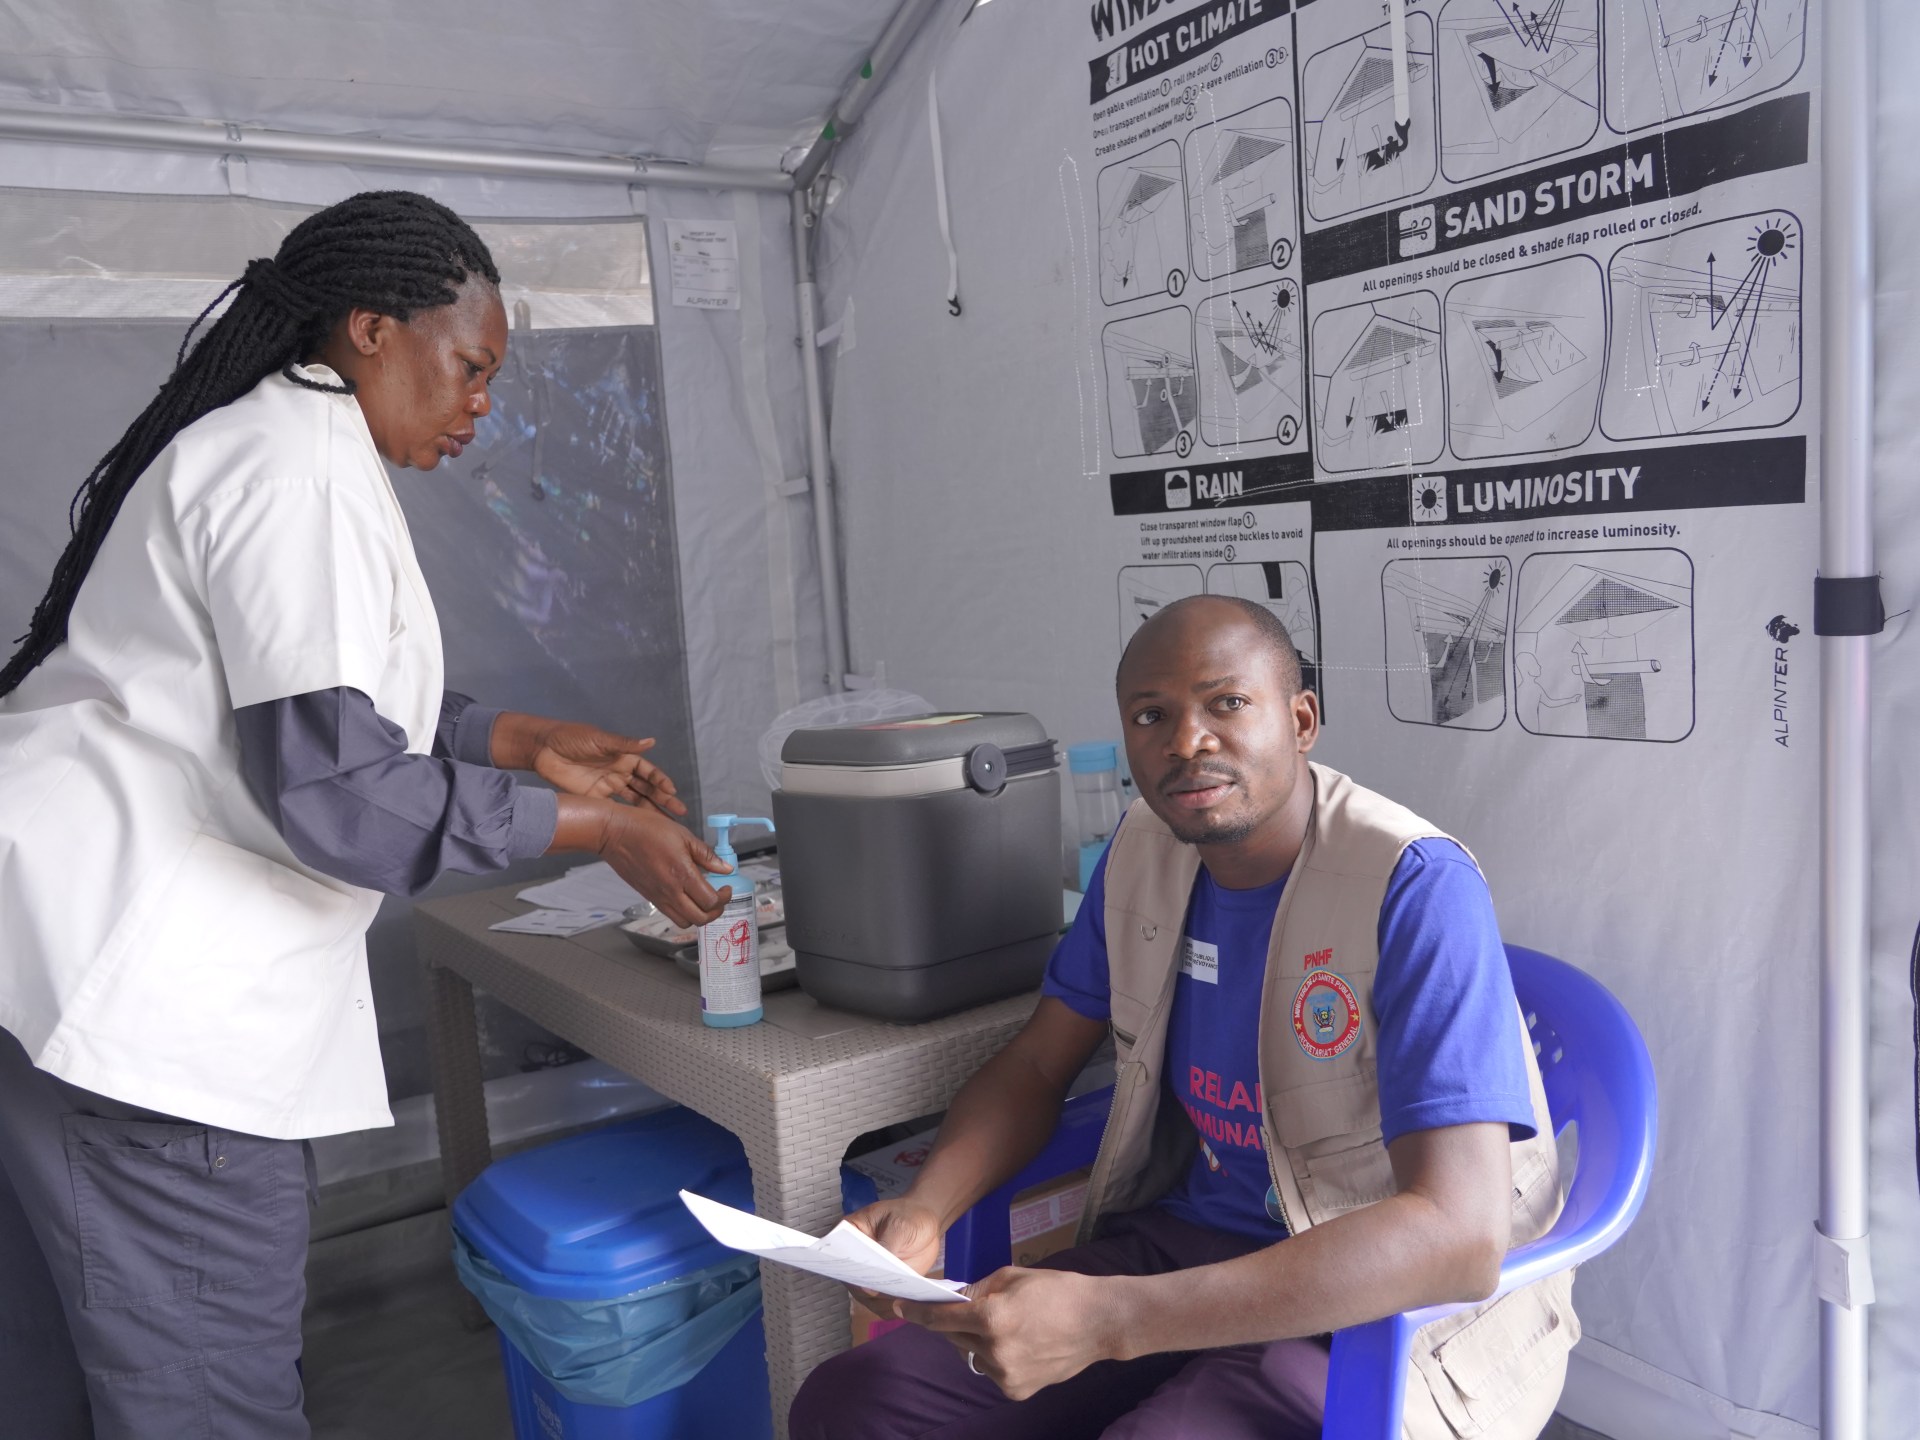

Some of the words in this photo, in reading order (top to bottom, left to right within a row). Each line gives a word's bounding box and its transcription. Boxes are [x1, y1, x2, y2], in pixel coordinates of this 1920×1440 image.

[1131, 32, 1171, 73] HOT
[1176, 0, 1263, 53] CLIMATE
[1106, 102, 1124, 118] gable
[1126, 88, 1160, 106] ventilation
[1186, 68, 1196, 80] the
[1197, 62, 1210, 76] door
[1109, 111, 1147, 133] transparent
[1148, 101, 1170, 118] window
[1170, 95, 1182, 108] flap
[1206, 76, 1222, 90] eave
[1224, 60, 1264, 82] ventilation
[1095, 142, 1116, 157] Create
[1117, 134, 1138, 148] shades
[1138, 128, 1150, 140] with
[1152, 119, 1173, 134] window
[1174, 112, 1185, 124] flap
[1444, 190, 1527, 238] SAND
[1534, 152, 1654, 216] STORM
[1362, 280, 1377, 292] All
[1379, 271, 1424, 290] openings
[1426, 260, 1460, 278] should
[1462, 258, 1476, 270] be
[1480, 248, 1515, 266] closed
[1518, 245, 1528, 258] &
[1531, 237, 1564, 254] shade
[1566, 231, 1590, 246] flap
[1593, 218, 1636, 240] rolled
[1640, 217, 1656, 230] or
[1660, 202, 1702, 226] closed.
[1196, 470, 1244, 500] RAIN
[1456, 466, 1642, 513] LUMINOSITY
[1140, 522, 1158, 532] Close
[1158, 519, 1199, 531] transparent
[1200, 518, 1226, 528] window
[1228, 516, 1242, 528] flap
[1152, 538, 1160, 546] up
[1162, 533, 1204, 546] groundsheet
[1205, 533, 1217, 543] and
[1218, 532, 1238, 542] close
[1239, 530, 1270, 542] buckles
[1271, 530, 1280, 540] to
[1281, 528, 1303, 539] avoid
[1386, 538, 1400, 549] All
[1402, 536, 1446, 550] openings
[1449, 534, 1486, 547] should
[1490, 534, 1502, 545] be
[1505, 530, 1534, 546] opened
[1536, 530, 1545, 541] to
[1548, 528, 1599, 540] increase
[1602, 522, 1680, 538] luminosity.
[1142, 551, 1160, 560] water
[1162, 548, 1200, 560] infiltrations
[1202, 548, 1223, 559] inside
[1774, 647, 1789, 748] ALPINTER
[1304, 948, 1332, 970] PNHF
[1335, 980, 1356, 1010] PUBLIQUE
[1334, 1026, 1358, 1054] GENERAL
